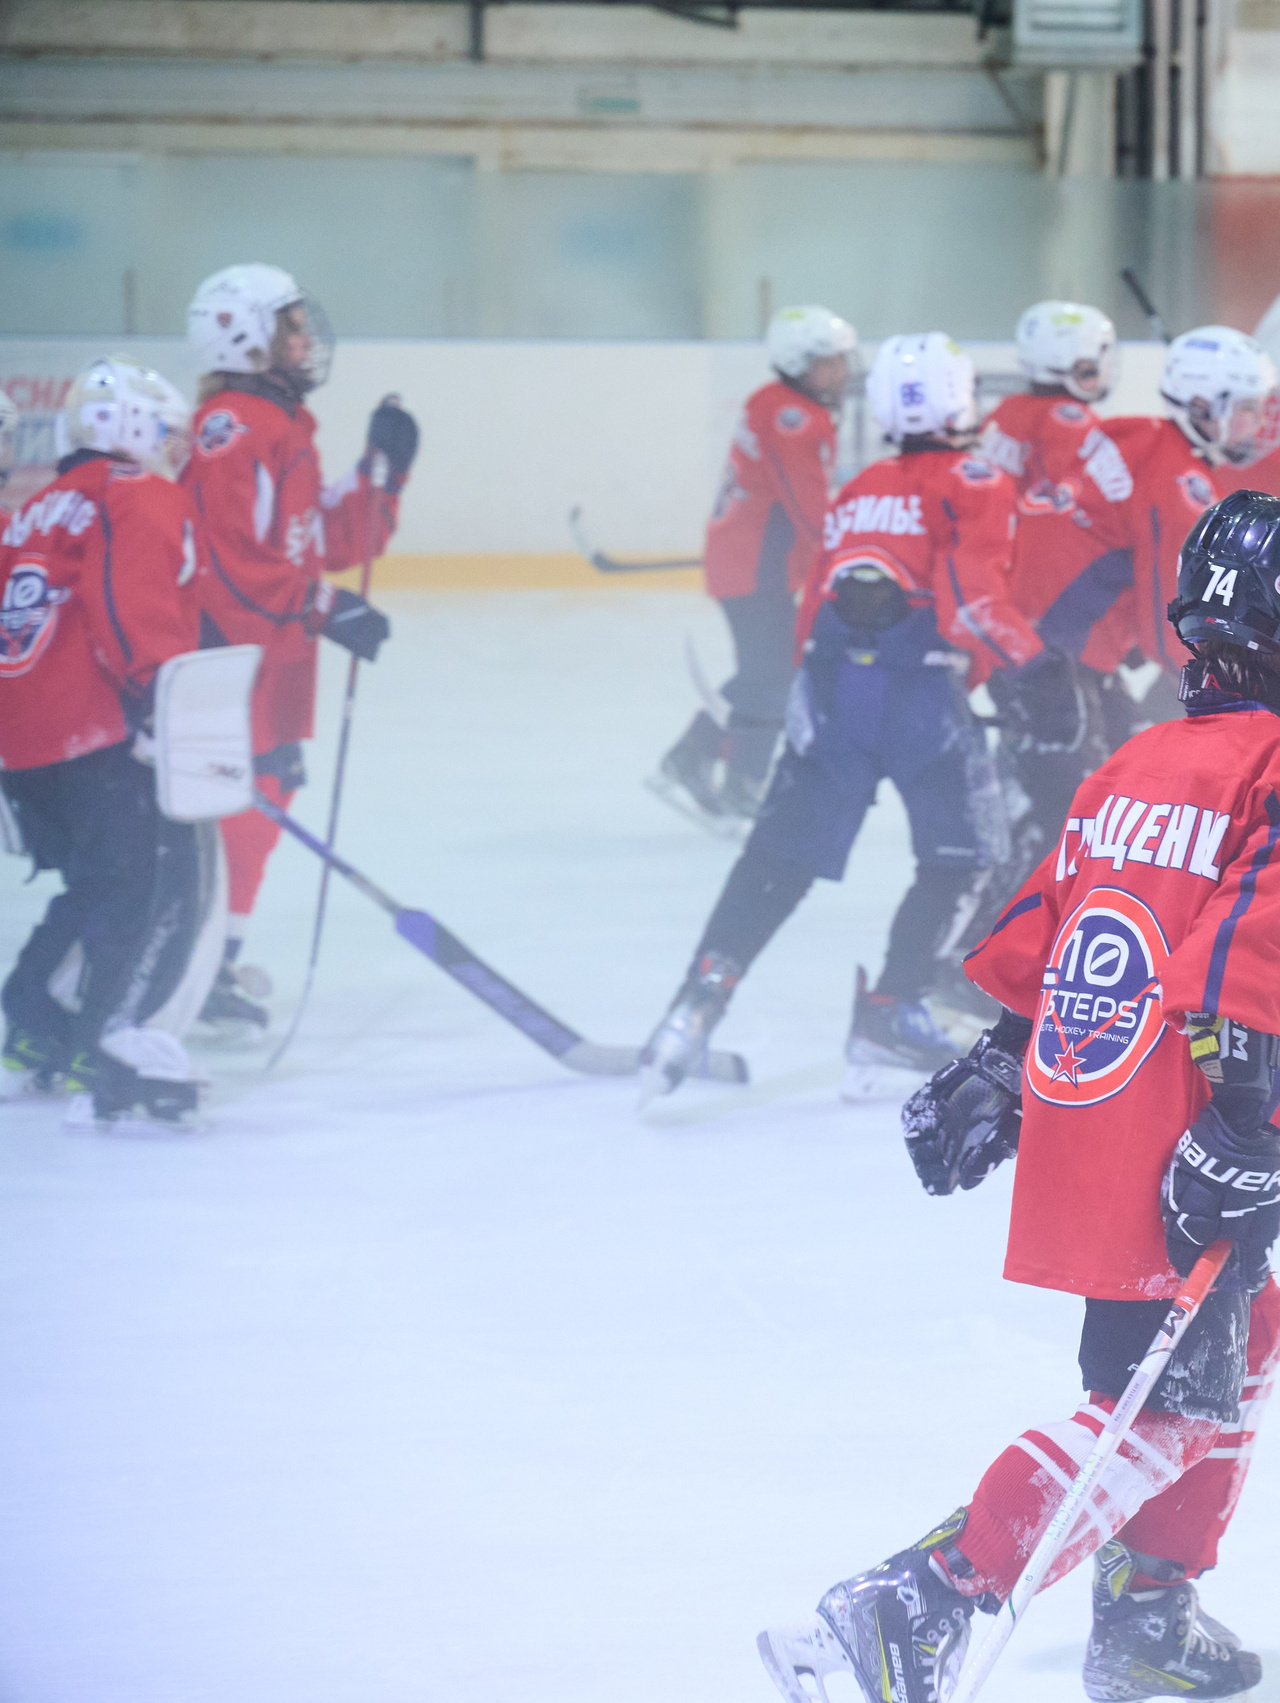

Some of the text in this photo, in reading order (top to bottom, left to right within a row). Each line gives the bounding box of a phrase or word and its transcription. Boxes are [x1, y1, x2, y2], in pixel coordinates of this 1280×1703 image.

[1202, 564, 1238, 607] 74
[1065, 929, 1130, 987] 10
[1088, 1029, 1130, 1045] TRAINING
